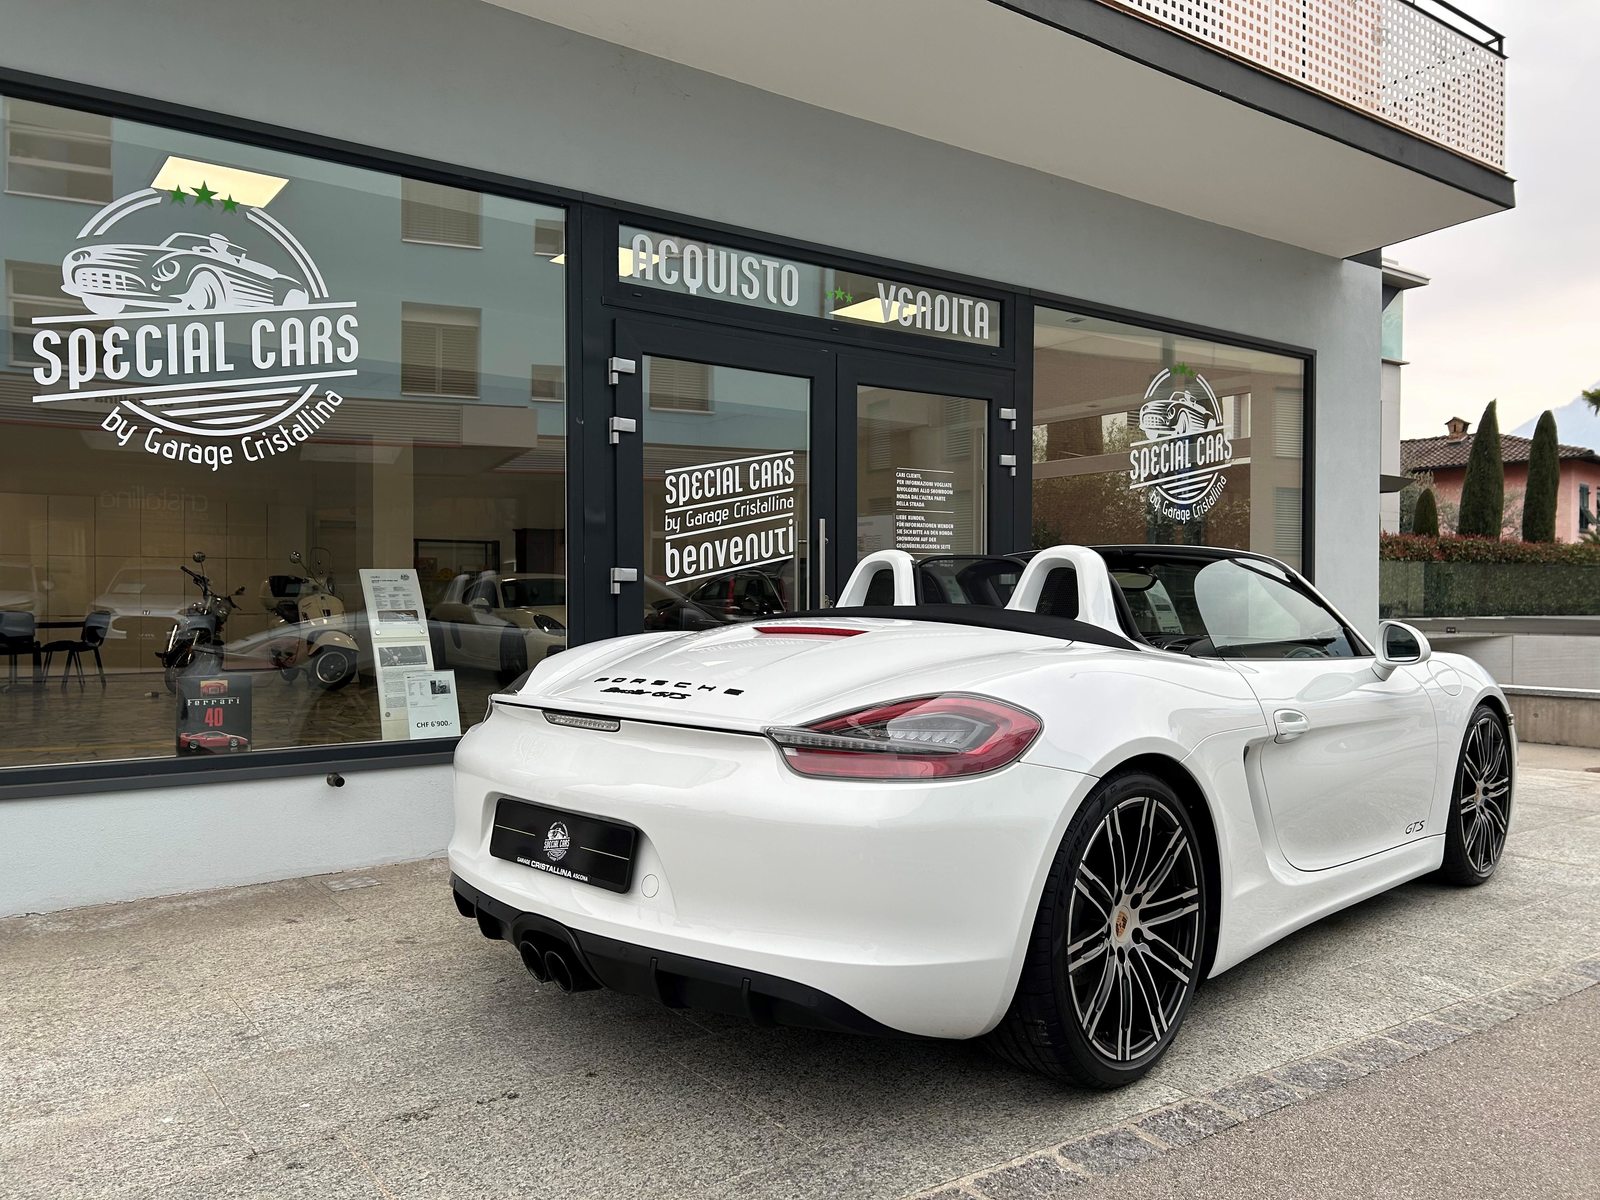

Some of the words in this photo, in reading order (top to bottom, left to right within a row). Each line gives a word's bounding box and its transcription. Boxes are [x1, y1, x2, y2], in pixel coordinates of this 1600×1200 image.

[632, 233, 799, 308] ACQUISTO
[877, 282, 990, 340] VENDITA
[32, 321, 234, 390] SPECIAL
[251, 314, 359, 369] CARS
[100, 406, 137, 446] by
[144, 427, 233, 472] Garage
[241, 389, 344, 462] Cristallina
[1129, 439, 1192, 482] SPECIAL
[1196, 431, 1232, 466] CARS
[665, 466, 743, 506] SPECIAL
[749, 457, 795, 490] CARS
[1162, 500, 1190, 524] Garage
[1192, 475, 1227, 518] Cristallina
[664, 515, 681, 533] by
[686, 510, 729, 525] Garage
[734, 496, 794, 518] Cristallina
[665, 518, 794, 578] benvenuti
[187, 697, 240, 706] Ferrari
[594, 677, 744, 696] PORSCHE
[203, 707, 223, 727] 40
[1405, 820, 1425, 834] GTS
[531, 860, 572, 878] CRISTALLINA
[573, 873, 588, 881] ASCONA
